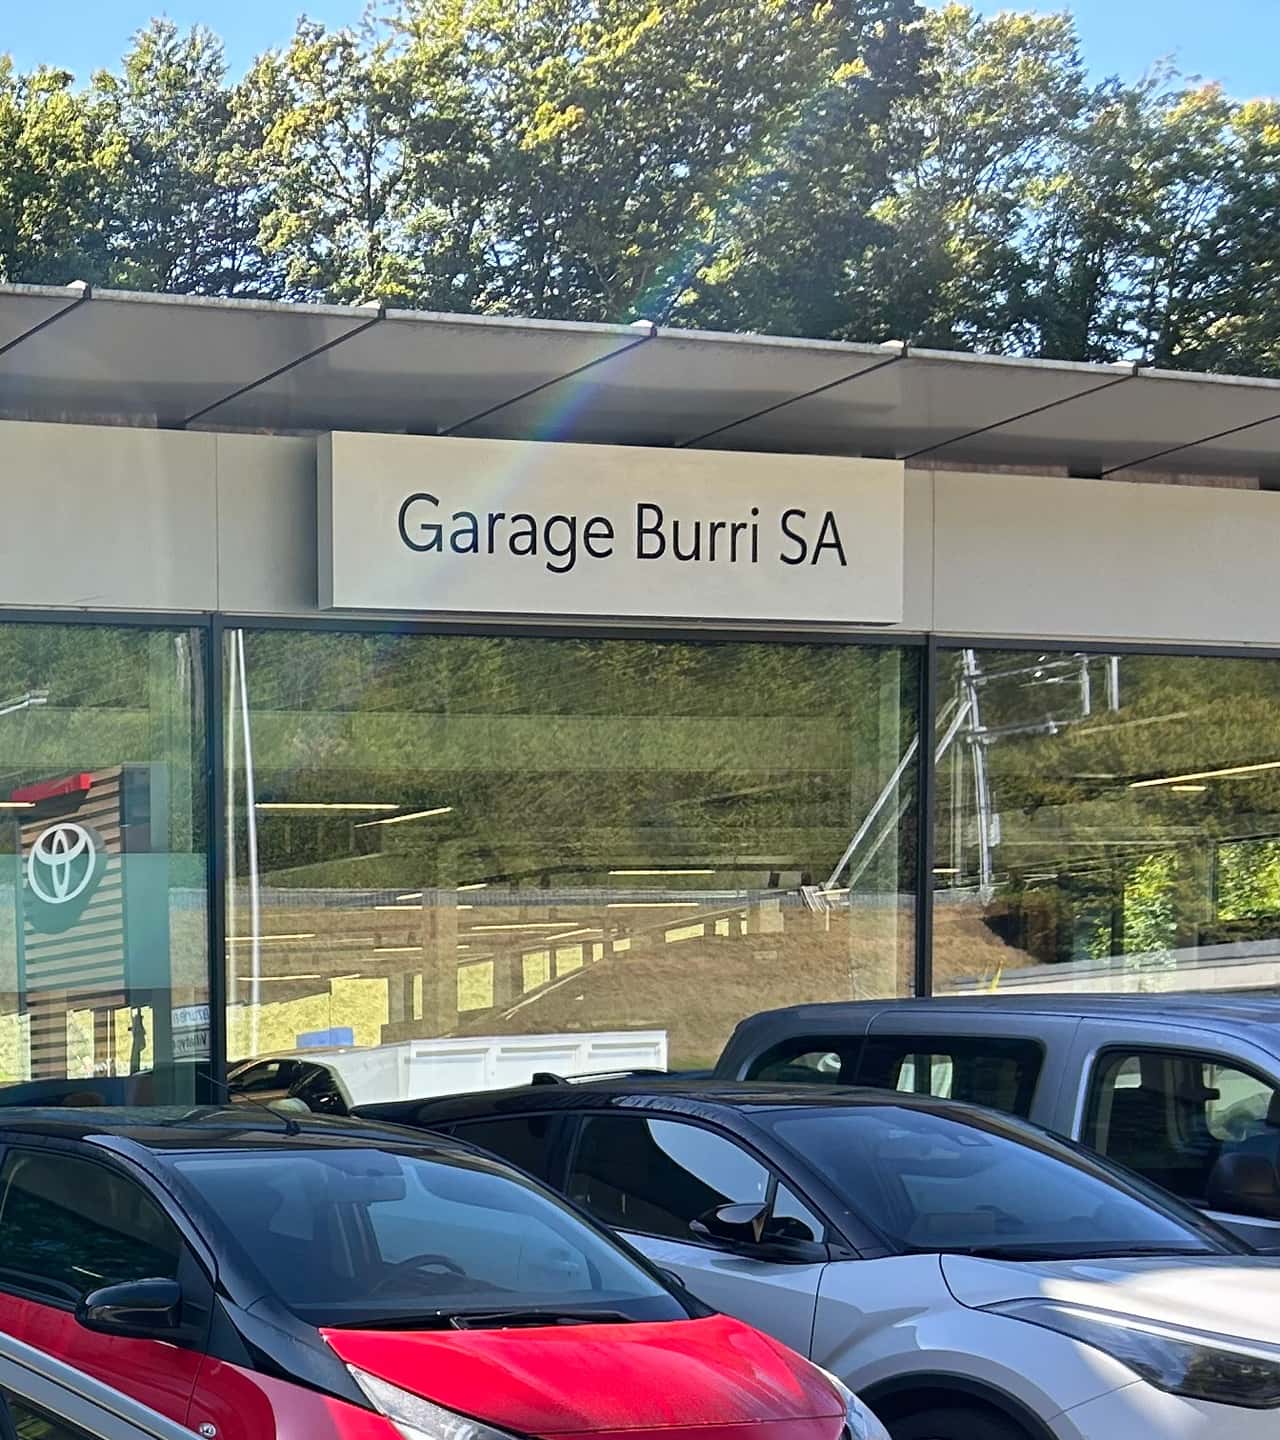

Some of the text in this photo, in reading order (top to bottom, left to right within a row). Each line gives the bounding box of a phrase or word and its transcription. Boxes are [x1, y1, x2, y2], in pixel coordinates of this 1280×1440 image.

[398, 493, 848, 573] Garage Burri SA
